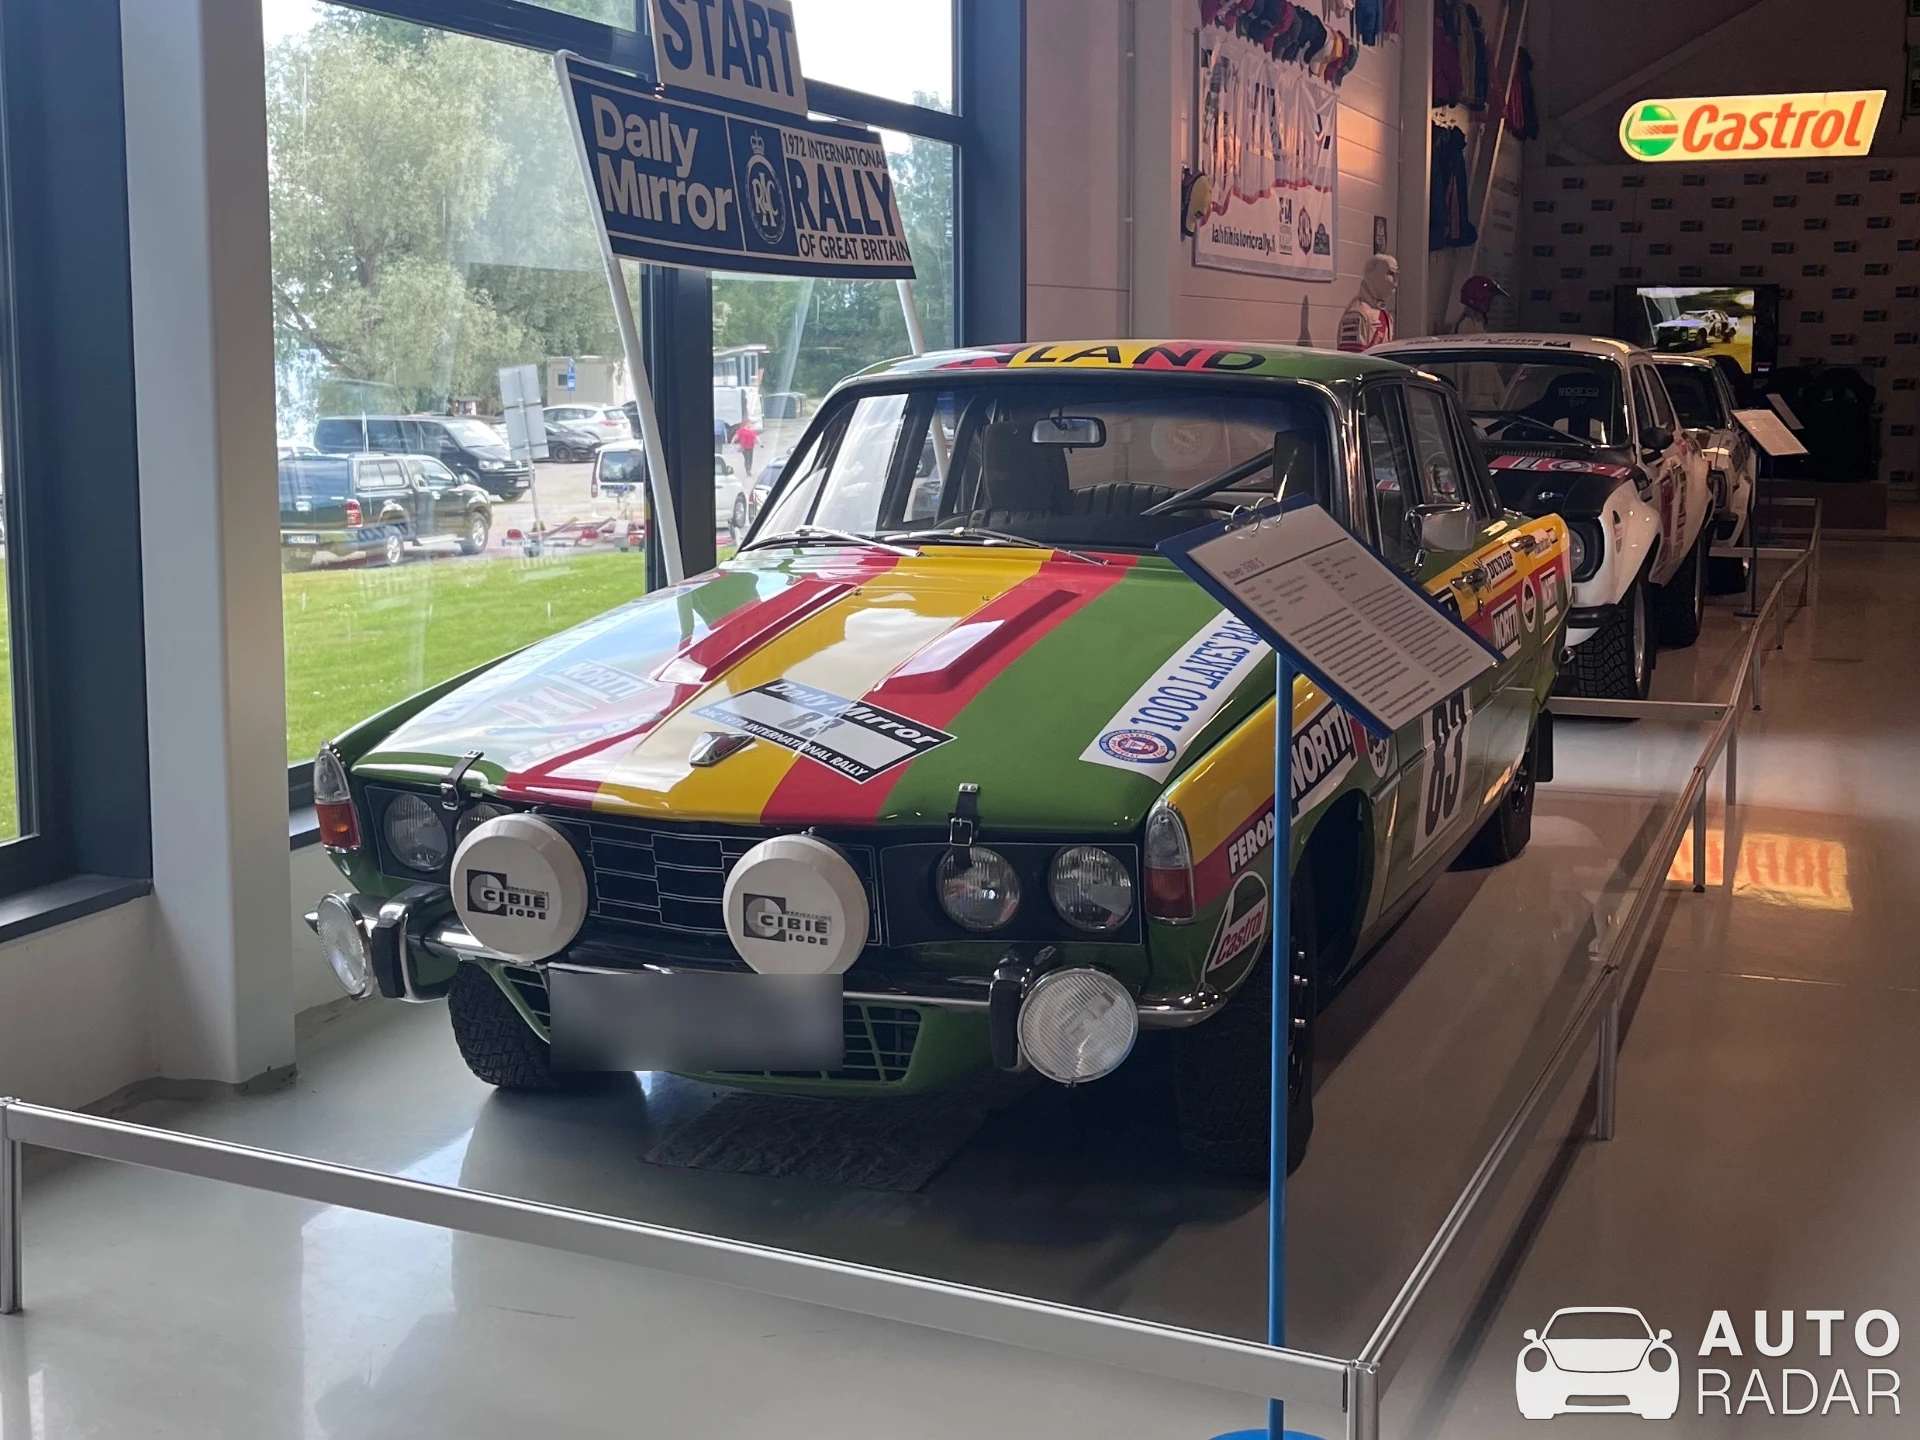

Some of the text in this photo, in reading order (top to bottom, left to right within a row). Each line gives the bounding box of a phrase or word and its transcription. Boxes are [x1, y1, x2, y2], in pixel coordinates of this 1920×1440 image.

[660, 0, 794, 97] START
[591, 94, 698, 178] Daily
[783, 133, 888, 168] 1972 INTERNATIONAL
[1682, 100, 1867, 153] Castrol
[597, 152, 732, 232] Mirror
[785, 158, 896, 236] RALLY
[799, 235, 911, 262] OF GREAT BRITAIN
[1486, 551, 1513, 579] DUNLOP
[765, 682, 837, 707] Daily
[1130, 686, 1208, 732] 1000
[746, 723, 834, 763] INTERNATIONAL
[830, 754, 869, 777] RALLY
[778, 712, 845, 737] 83
[1425, 692, 1467, 837] 83
[1229, 811, 1275, 874] FEROD
[509, 907, 547, 921] IODE
[788, 934, 829, 946] IODE
[1215, 904, 1266, 965] Castrol
